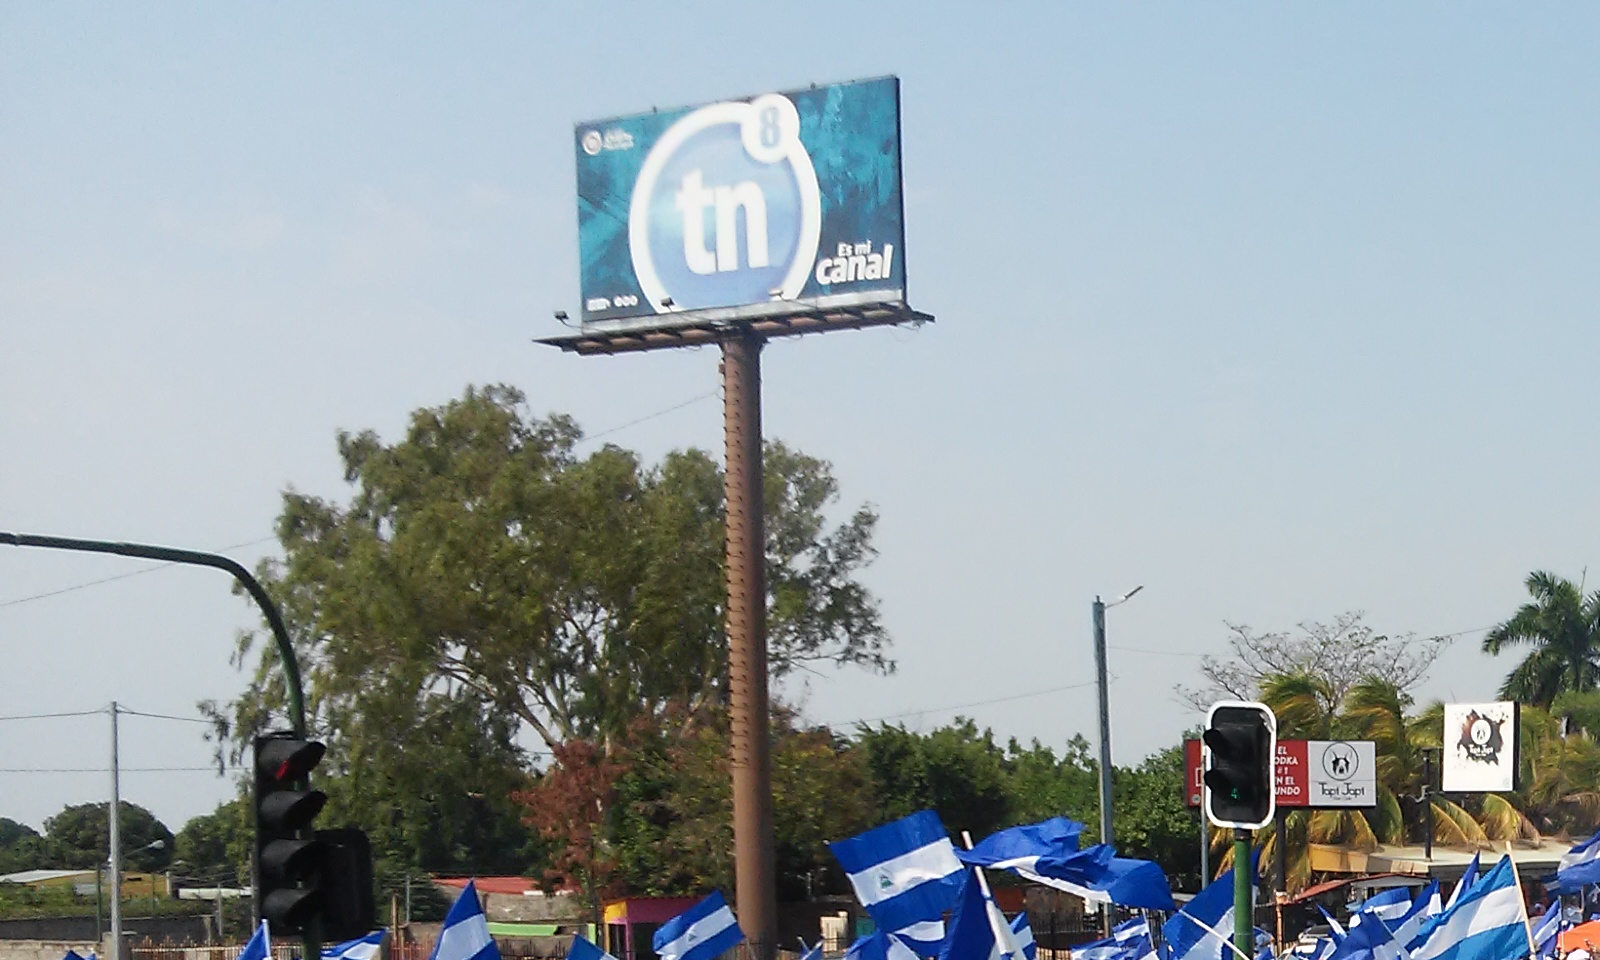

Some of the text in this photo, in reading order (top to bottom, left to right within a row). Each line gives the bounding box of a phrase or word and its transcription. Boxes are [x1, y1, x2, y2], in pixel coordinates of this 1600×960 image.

[759, 107, 781, 148] 8
[677, 170, 769, 275] tn
[838, 239, 872, 257] Es mi
[816, 243, 893, 285] canal
[1278, 746, 1288, 754] EL
[1275, 757, 1298, 765] ODKA
[1284, 776, 1296, 785] EL
[1275, 786, 1301, 796] UNDO
